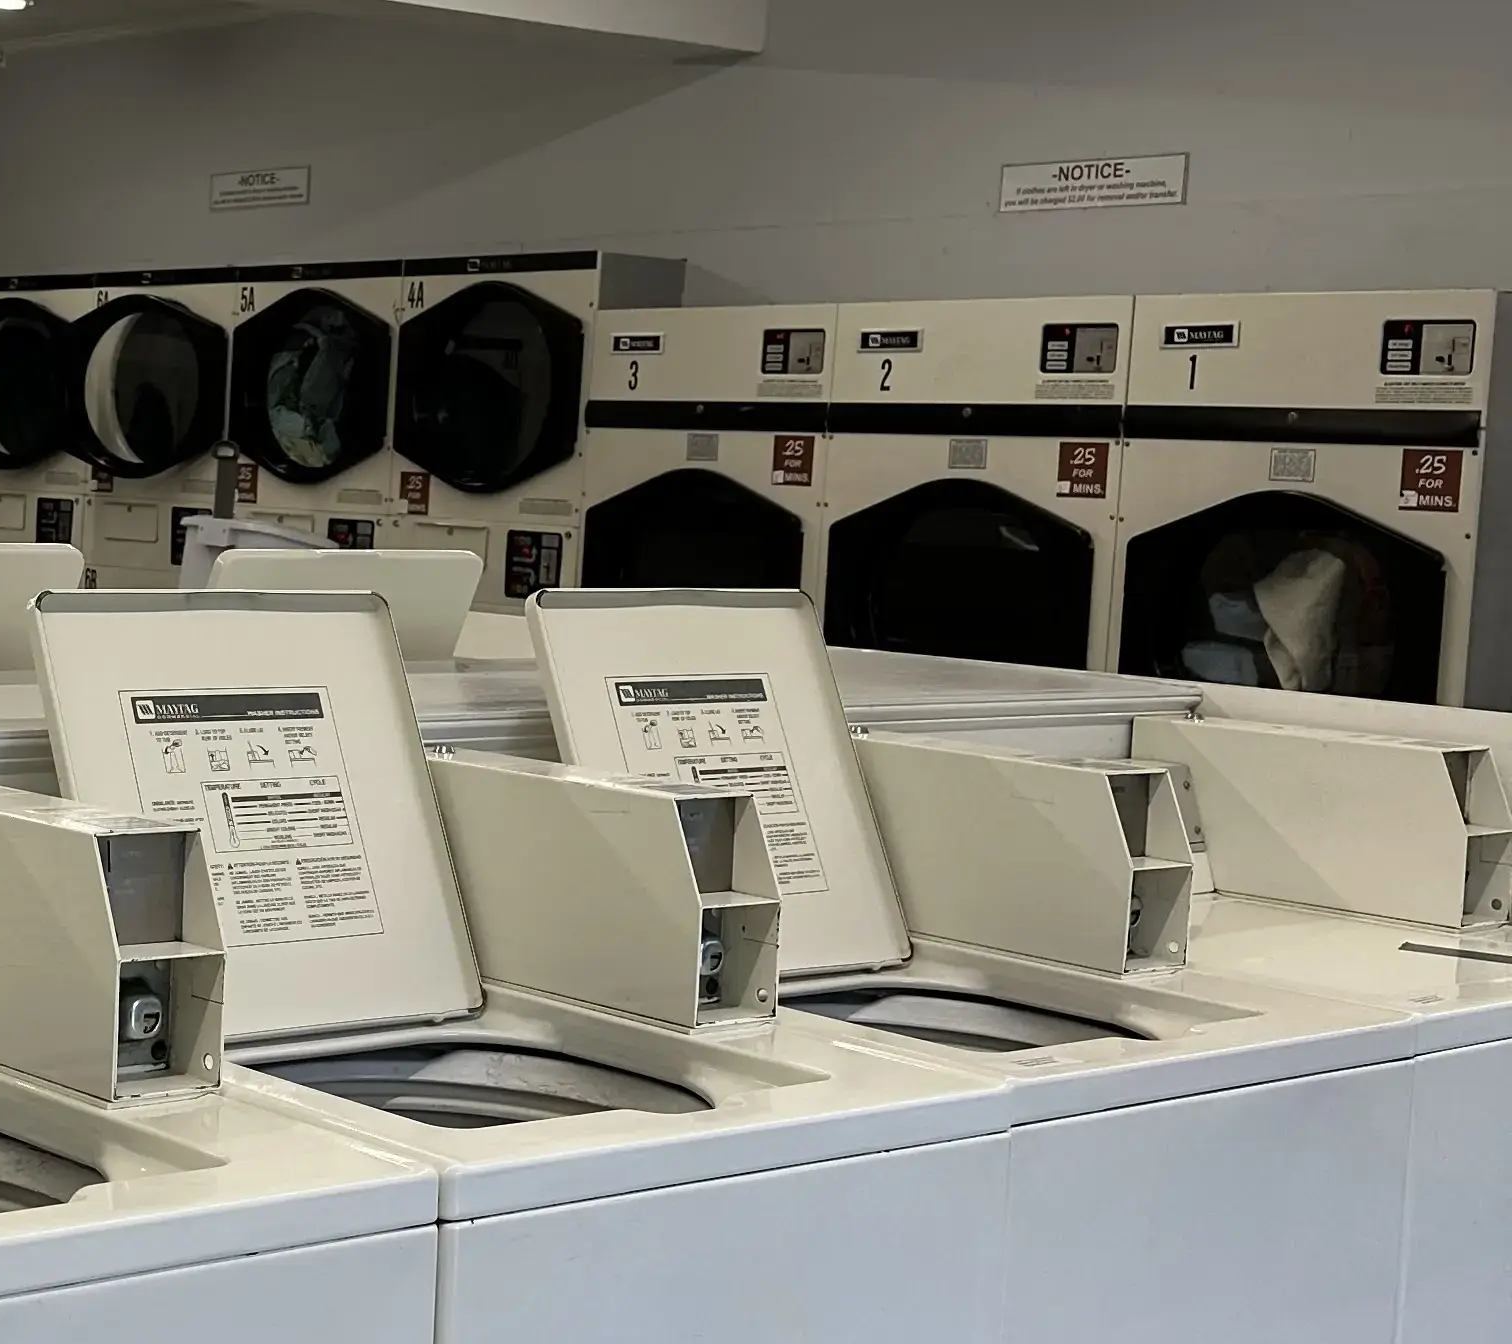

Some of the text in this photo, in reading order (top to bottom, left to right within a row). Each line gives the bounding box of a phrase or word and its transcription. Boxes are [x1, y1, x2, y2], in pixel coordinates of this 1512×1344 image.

[240, 286, 255, 312] 5A
[407, 281, 424, 309] 4A
[1189, 330, 1225, 340] MAYTAG
[628, 360, 639, 391] 3
[879, 358, 893, 392] 2
[1189, 354, 1198, 390] 1
[1069, 447, 1096, 465] .25
[1415, 454, 1447, 475] .25
[1072, 468, 1094, 478] FOR
[1418, 478, 1444, 489] FOR
[155, 703, 200, 715] MAYTAG
